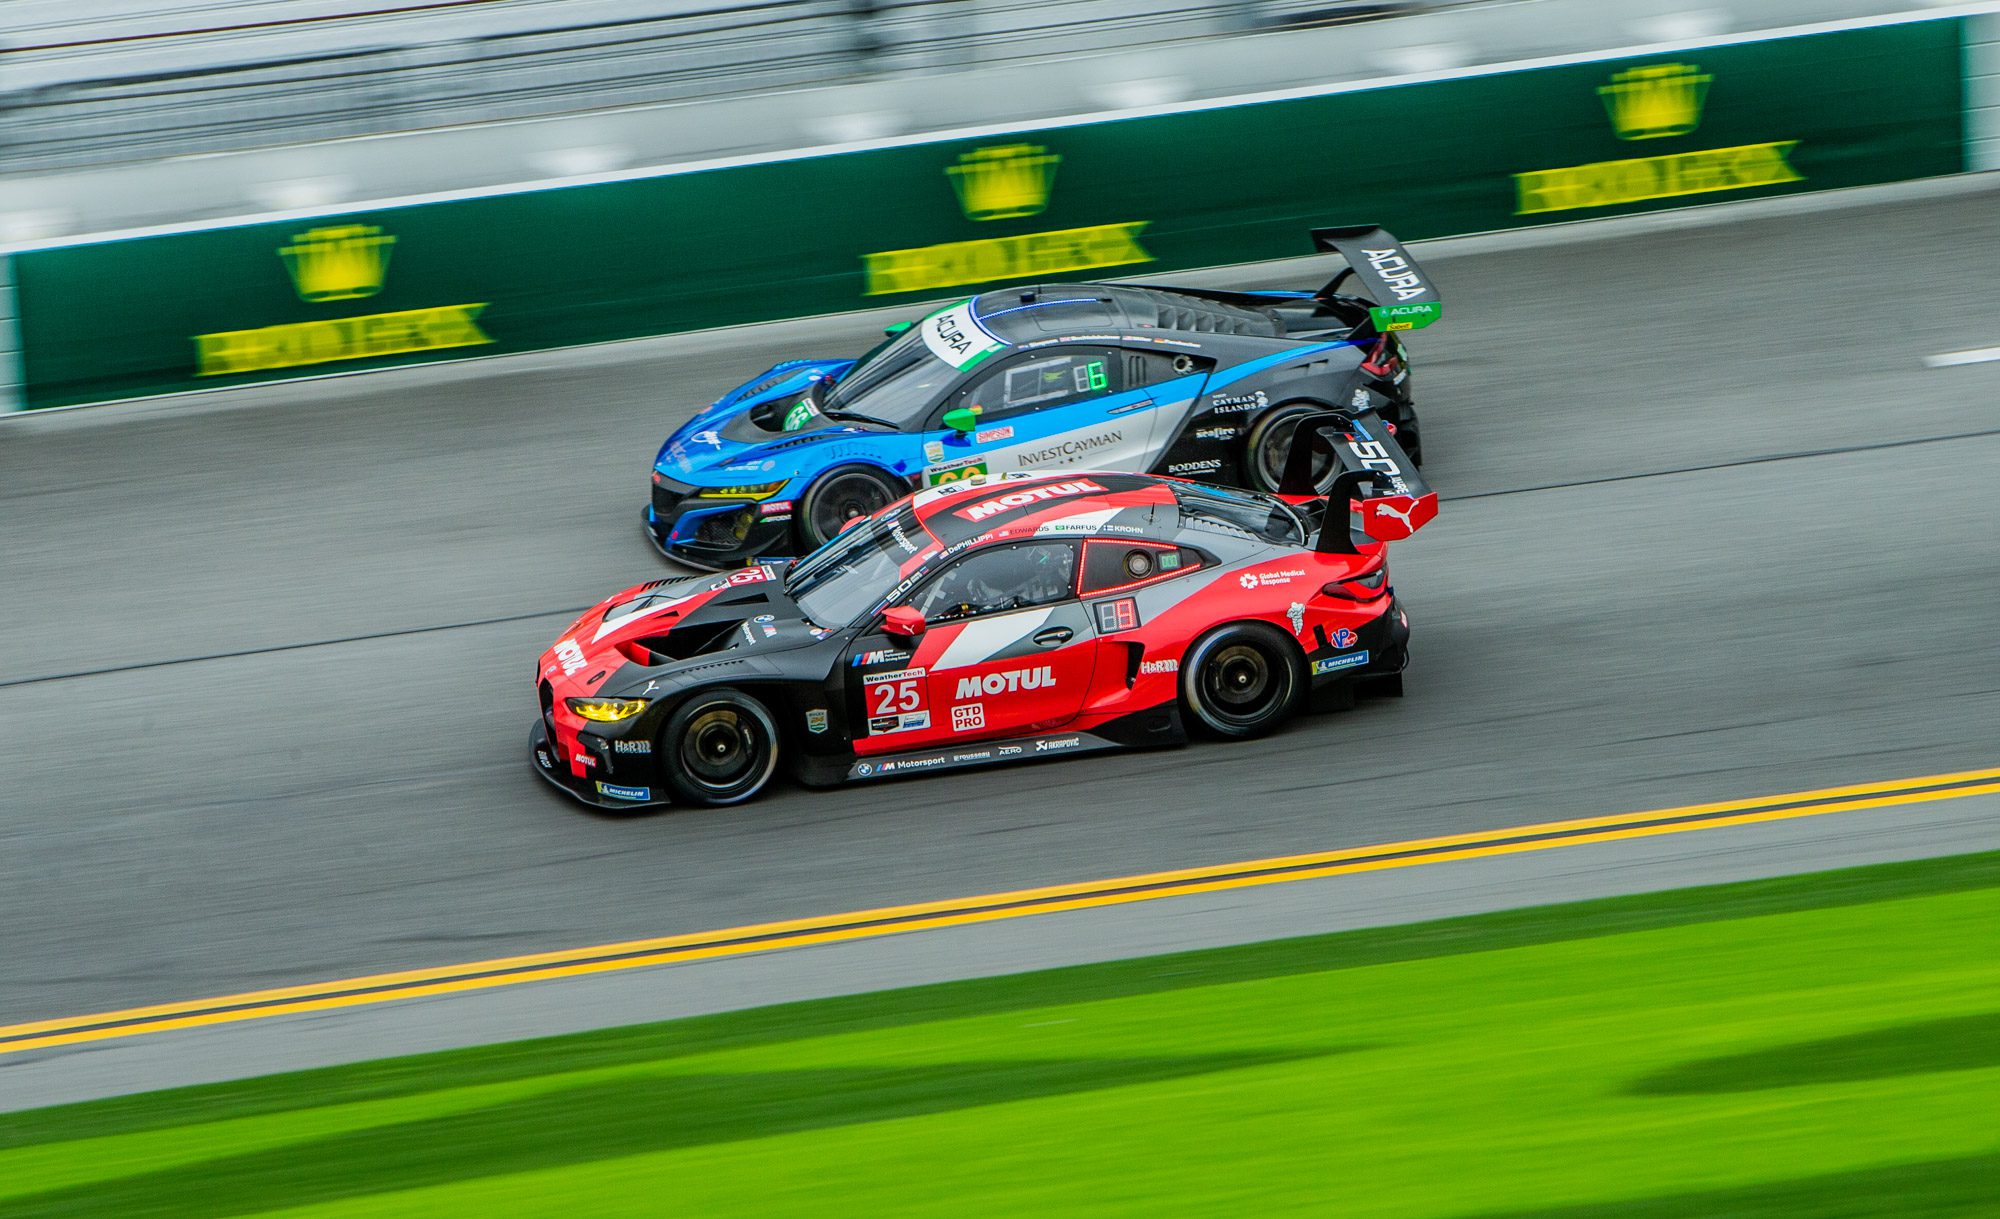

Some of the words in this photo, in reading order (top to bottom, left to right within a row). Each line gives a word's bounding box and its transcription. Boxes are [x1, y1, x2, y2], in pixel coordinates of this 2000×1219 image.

[1361, 248, 1426, 301] ACURA
[1390, 305, 1432, 316] ACURA
[937, 314, 972, 355] ACURA
[1213, 394, 1256, 406] CAYMAN
[1214, 402, 1257, 414] ISLANDS
[930, 456, 983, 474] WeatherTech
[1168, 459, 1222, 473] BODDENS
[966, 481, 1101, 520] MOTUL
[1009, 526, 1050, 535] EDWARDS
[1114, 524, 1144, 534] KROHN
[947, 533, 994, 554] DePHILLIPPI
[730, 568, 764, 584] 25
[1259, 571, 1281, 579] Global
[1280, 568, 1306, 577] Medical
[1331, 628, 1350, 649] VP
[1327, 655, 1364, 668] MICHELIN
[865, 669, 924, 683] WeatherTech
[954, 665, 1057, 700] MOTUL
[874, 680, 920, 715] 25
[953, 705, 981, 718] GTD
[955, 716, 983, 729] PRO
[614, 740, 640, 753] H&R
[999, 747, 1023, 756] AERO
[575, 753, 597, 767] MOTUL
[897, 756, 946, 770] Motorsport
[609, 787, 645, 797] MICHELIN
